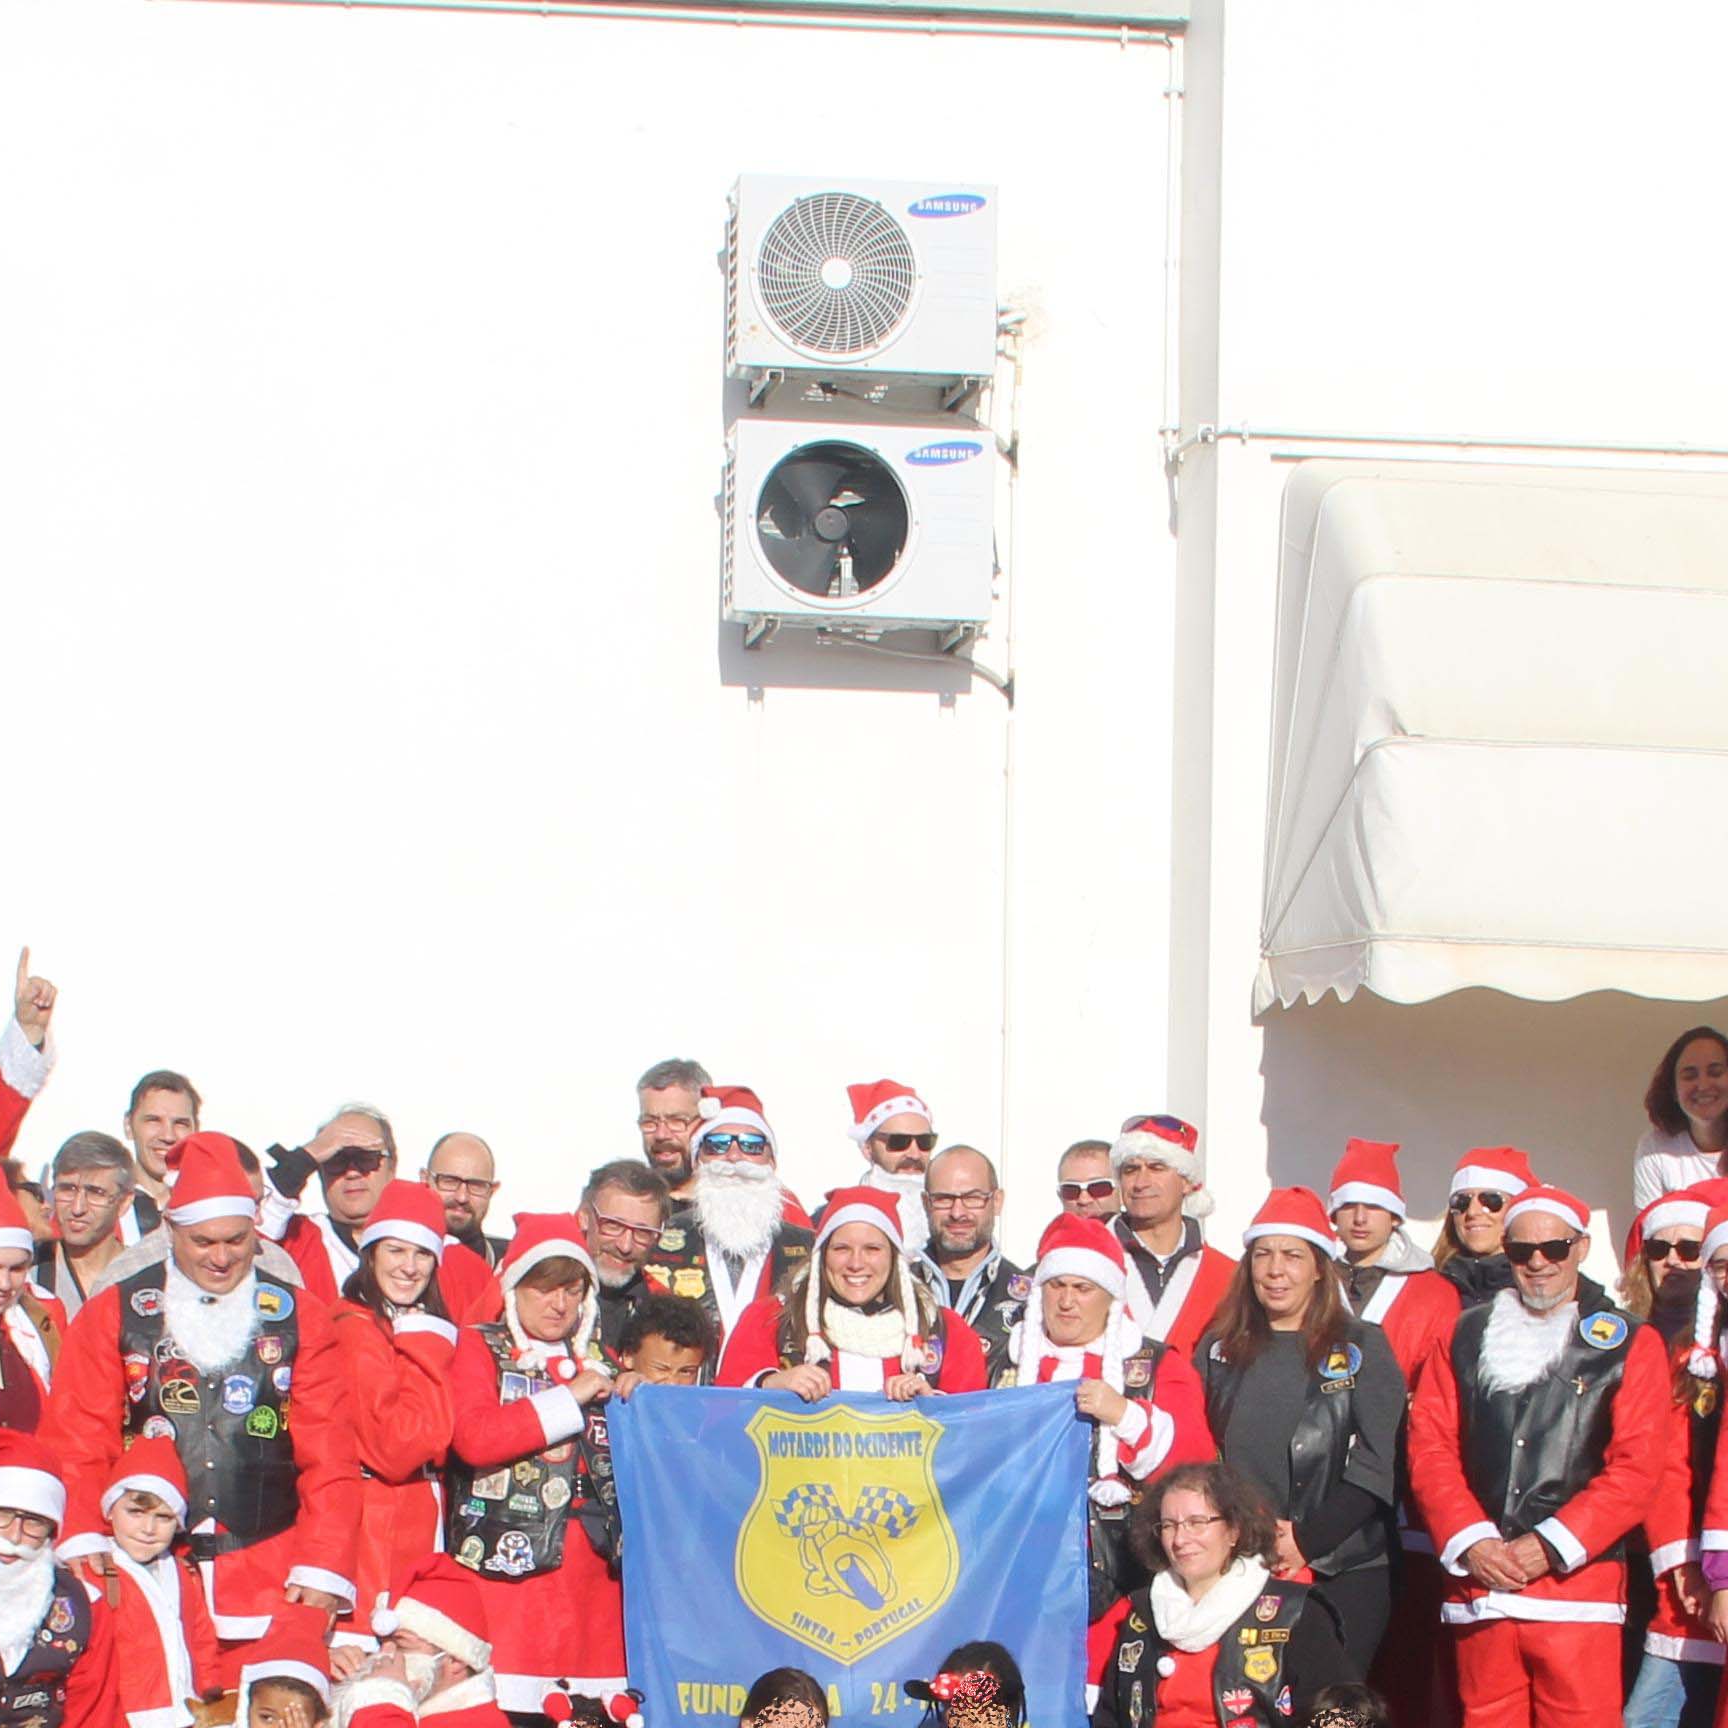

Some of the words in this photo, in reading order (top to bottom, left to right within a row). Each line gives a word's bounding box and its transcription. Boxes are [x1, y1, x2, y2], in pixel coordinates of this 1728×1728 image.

[917, 198, 977, 213] SAMSUNG
[914, 446, 975, 460] SAMSUNG
[767, 1431, 830, 1459] MOTARDS
[832, 1431, 852, 1458] DO
[854, 1431, 923, 1458] OCIDENTE
[790, 1611, 837, 1645] SINTRA
[854, 1597, 924, 1646] PORTUGAL
[870, 1682, 897, 1716] 24
